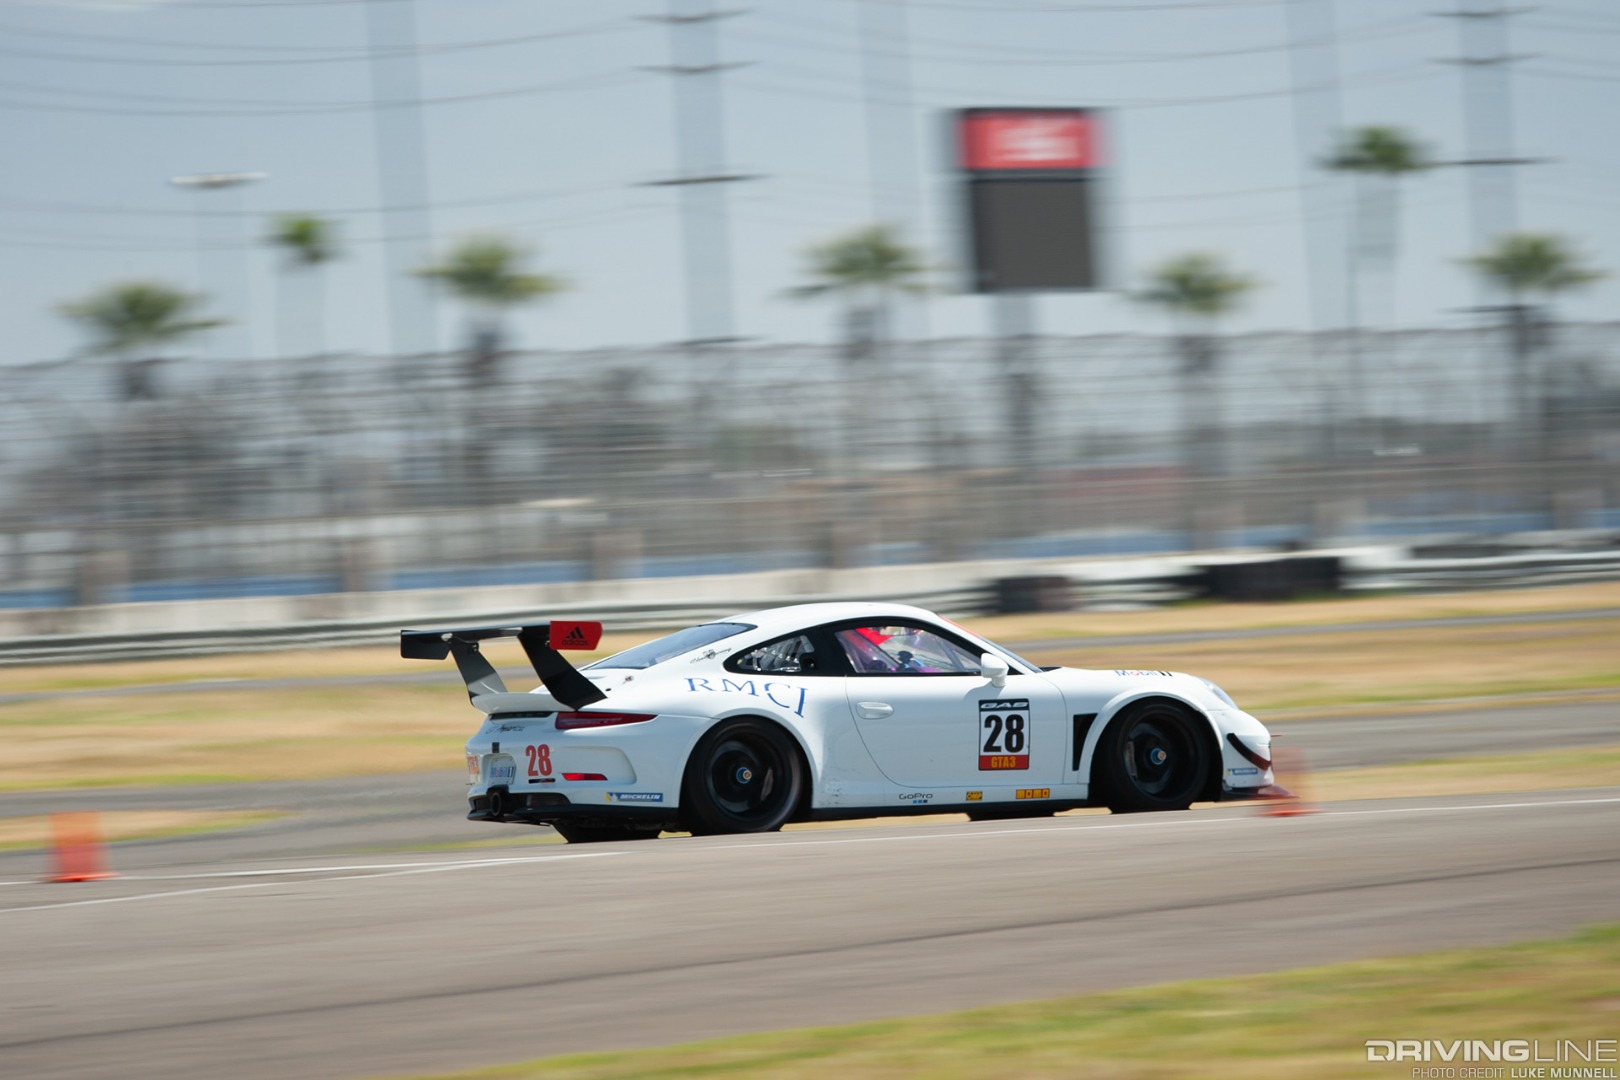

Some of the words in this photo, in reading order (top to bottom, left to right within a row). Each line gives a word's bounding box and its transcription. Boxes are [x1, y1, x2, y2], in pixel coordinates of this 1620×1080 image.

[684, 677, 808, 718] RMCI
[983, 714, 1024, 753] 28
[525, 744, 552, 777] 28
[991, 756, 1016, 768] GTA3
[899, 792, 933, 800] GoPro
[1017, 790, 1049, 798] MOMO
